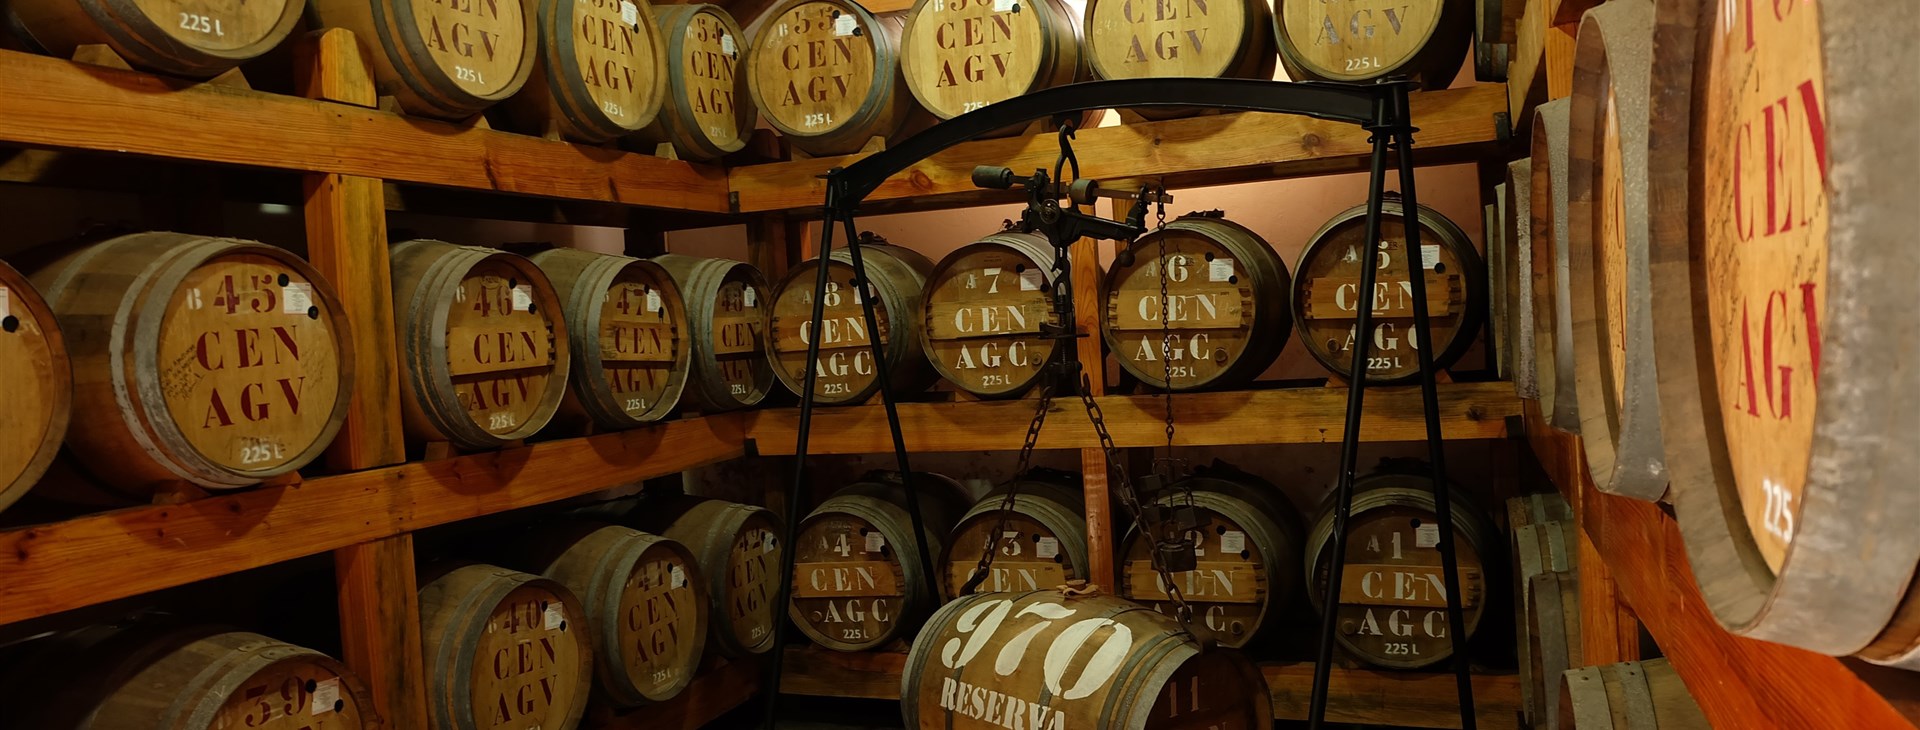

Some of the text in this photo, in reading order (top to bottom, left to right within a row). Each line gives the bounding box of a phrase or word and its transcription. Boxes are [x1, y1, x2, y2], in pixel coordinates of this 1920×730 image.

[180, 12, 224, 36] 225 L
[582, 14, 634, 56] CEN
[697, 18, 722, 45] 54
[779, 23, 788, 37] B
[794, 6, 835, 34] 55
[936, 12, 1011, 49] CEN
[1314, 6, 1408, 46] AGV
[427, 15, 500, 62] AGV
[1124, 28, 1208, 63] AGV
[691, 50, 734, 85] CEN
[782, 37, 853, 71] CEN
[1346, 57, 1380, 71] 225 L
[455, 66, 476, 83] 225
[585, 56, 636, 94] AGV
[936, 51, 1013, 88] AGV
[695, 87, 735, 114] AGV
[781, 73, 853, 107] AGV
[604, 101, 618, 116] 225
[805, 113, 824, 128] 225
[710, 126, 722, 137] 225
[1734, 79, 1826, 243] CEN
[1342, 244, 1359, 263] A
[965, 273, 977, 289] A
[983, 267, 1001, 294] 7
[1167, 255, 1189, 282] 6
[186, 288, 203, 310] B
[214, 274, 276, 314] 45
[473, 285, 513, 317] 46
[616, 288, 644, 316] 47
[824, 281, 841, 307] 8
[1138, 293, 1217, 322] CEN
[955, 304, 1026, 333] CEN
[196, 324, 300, 371] CEN
[473, 330, 538, 364] CEN
[614, 327, 662, 354] CEN
[722, 322, 758, 348] CEN
[1134, 333, 1210, 361] AGC
[955, 341, 1028, 369] AGC
[1367, 357, 1402, 369] 225 L
[610, 368, 657, 393] AGV
[981, 374, 1012, 387] 225 L
[1190, 366, 1196, 377] L
[468, 374, 531, 411] AGV
[731, 384, 742, 395] 225
[824, 382, 851, 394] 225 L
[203, 376, 305, 429] AGV
[626, 399, 641, 411] 225
[489, 413, 507, 430] 225
[242, 443, 283, 464] 225 L
[834, 533, 851, 557] 4
[1002, 531, 1022, 556] 3
[1366, 534, 1380, 552] A
[1391, 531, 1403, 560] 1
[732, 555, 767, 589] CEN
[810, 566, 875, 592] CEN
[1361, 571, 1447, 601] CEN
[628, 591, 679, 632] CEN
[734, 583, 767, 621] AGV
[824, 598, 889, 623] AGC
[503, 600, 541, 635] 40
[1357, 608, 1446, 638] AGC
[634, 618, 681, 667] AGV
[752, 627, 762, 639] 225
[843, 629, 869, 639] 225 L
[493, 635, 556, 681] CEN
[941, 599, 1133, 700] 970
[1384, 643, 1420, 655] 225 L
[652, 671, 667, 684] 225
[245, 676, 307, 727] 39
[493, 675, 557, 726] AGV
[940, 677, 1065, 730] RESERVA
[1169, 675, 1200, 719] 11
